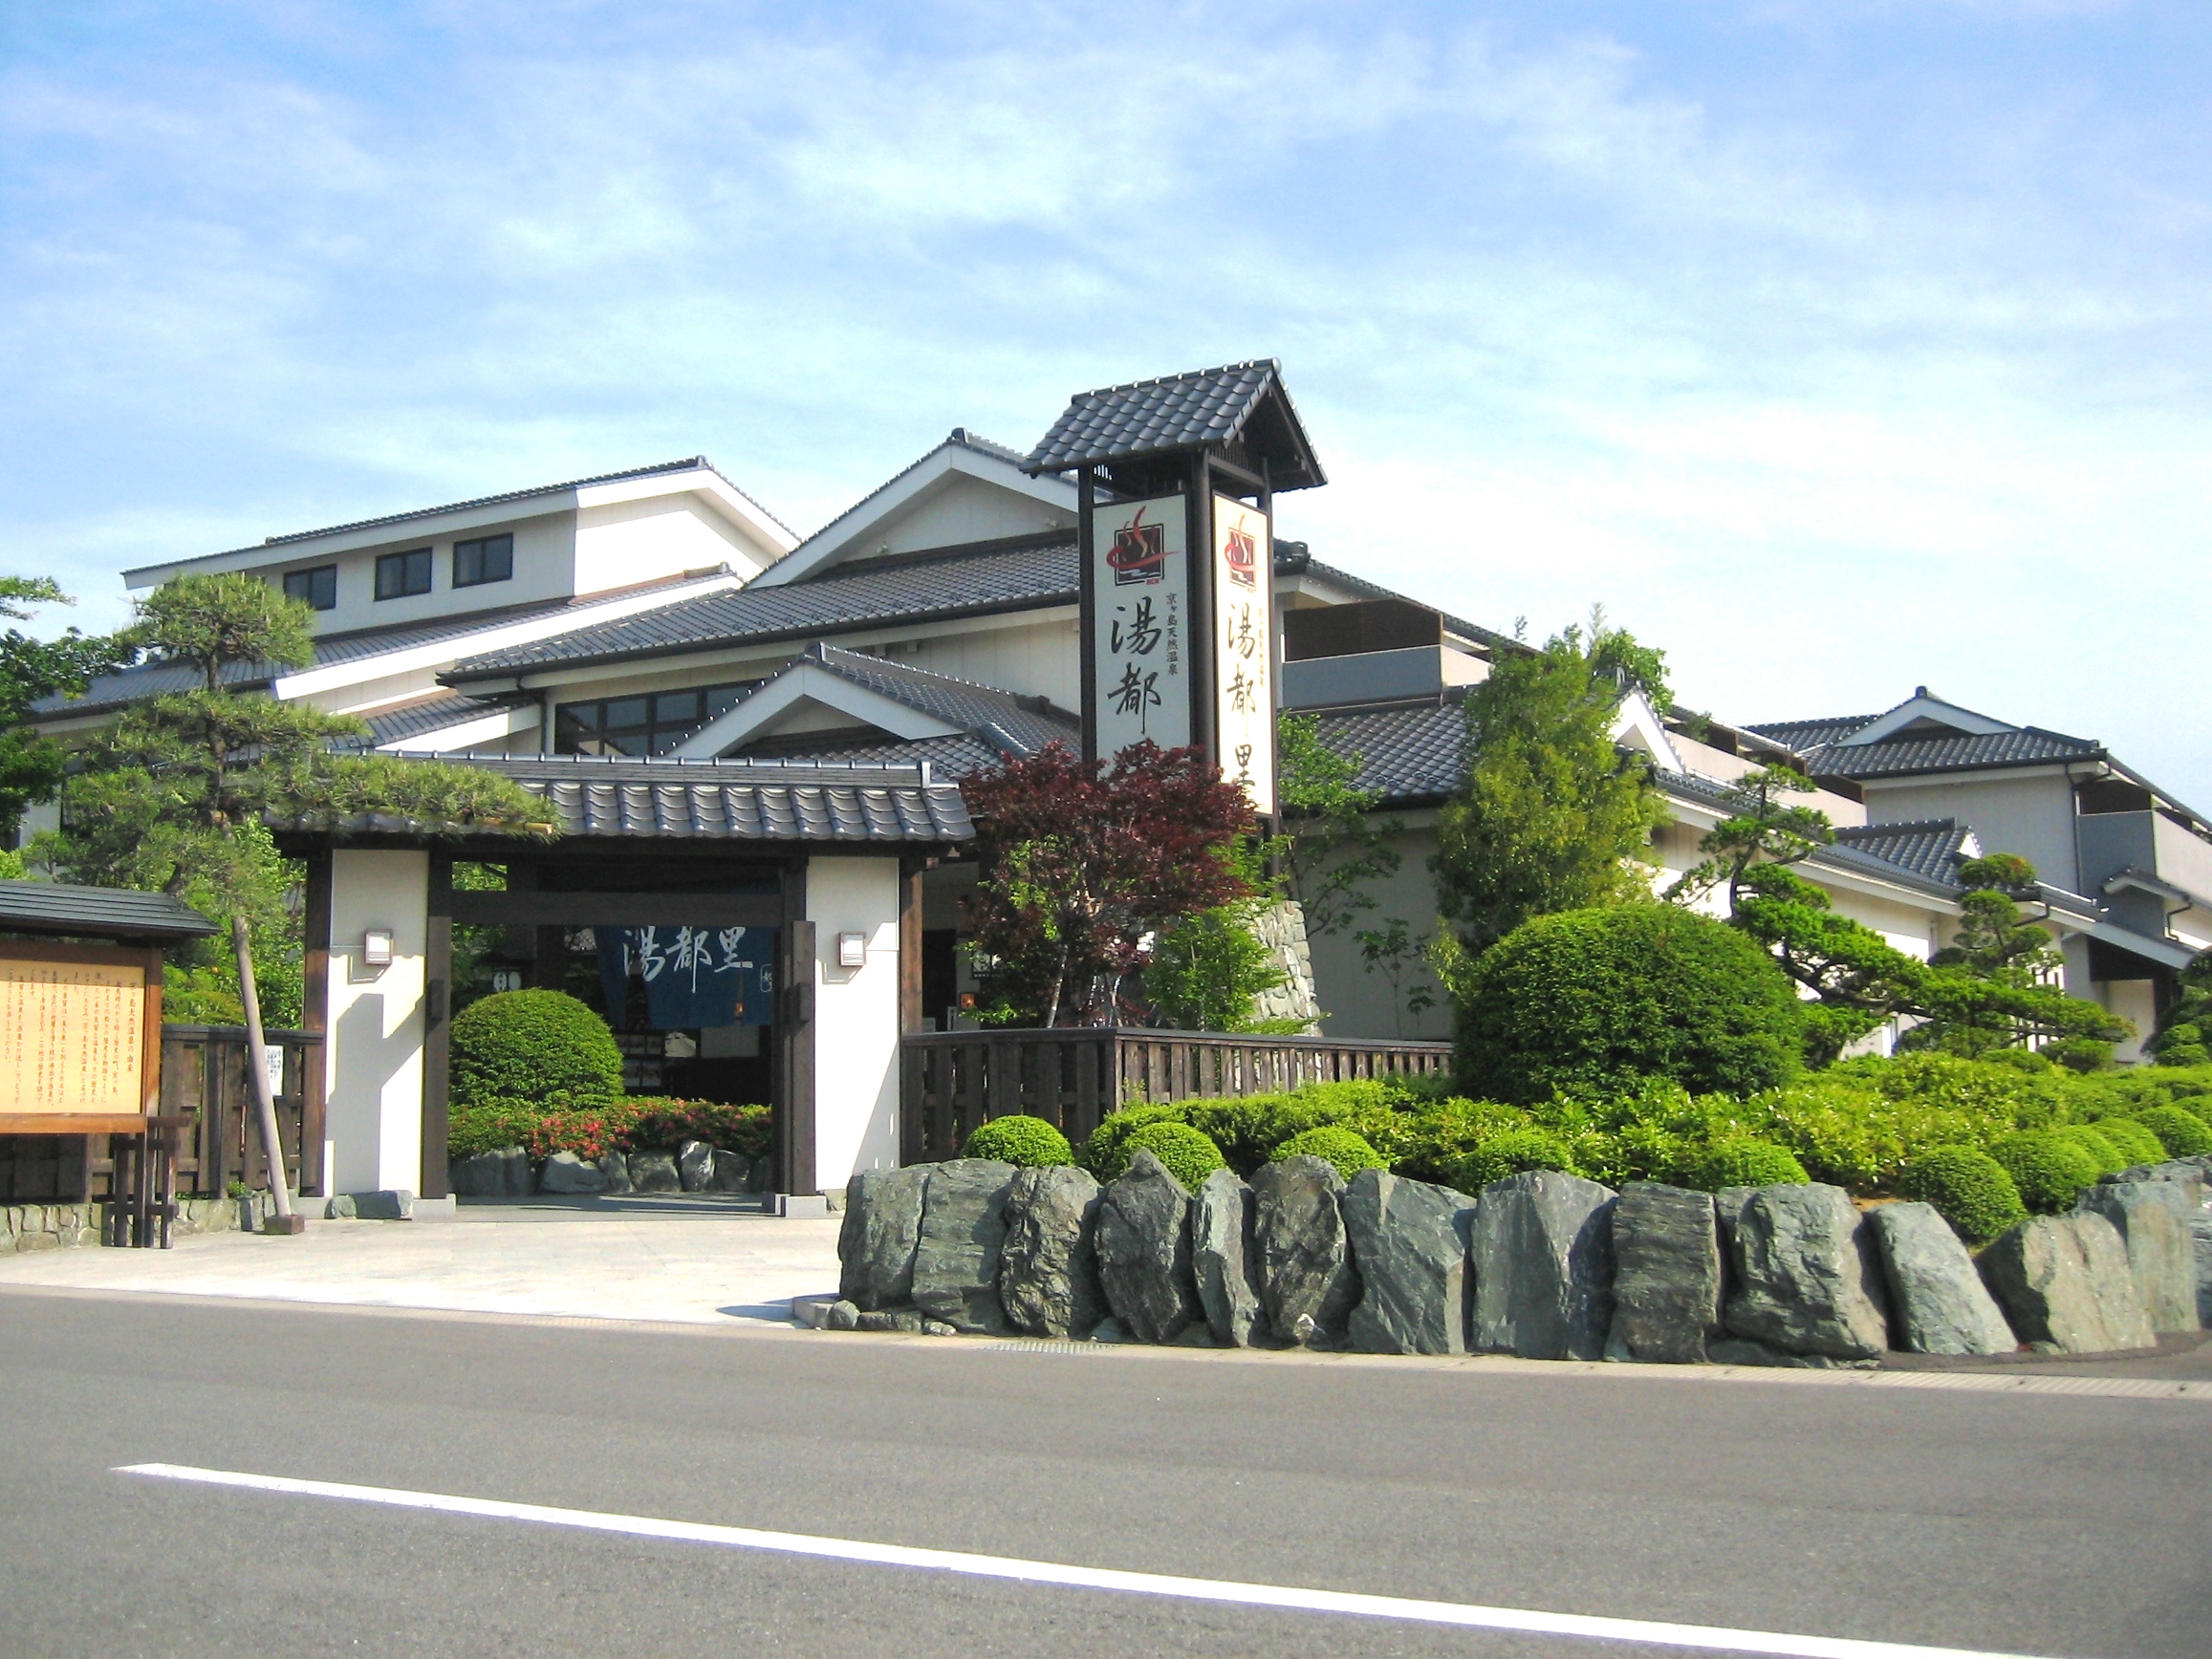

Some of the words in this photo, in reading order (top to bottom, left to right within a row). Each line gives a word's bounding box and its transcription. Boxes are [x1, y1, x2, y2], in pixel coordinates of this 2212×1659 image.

[1108, 595, 1162, 753] 湯都
[1165, 592, 1179, 676] 京ヶ島天然温泉
[1226, 603, 1256, 786] 湯都里
[623, 925, 753, 995] 湯都里
